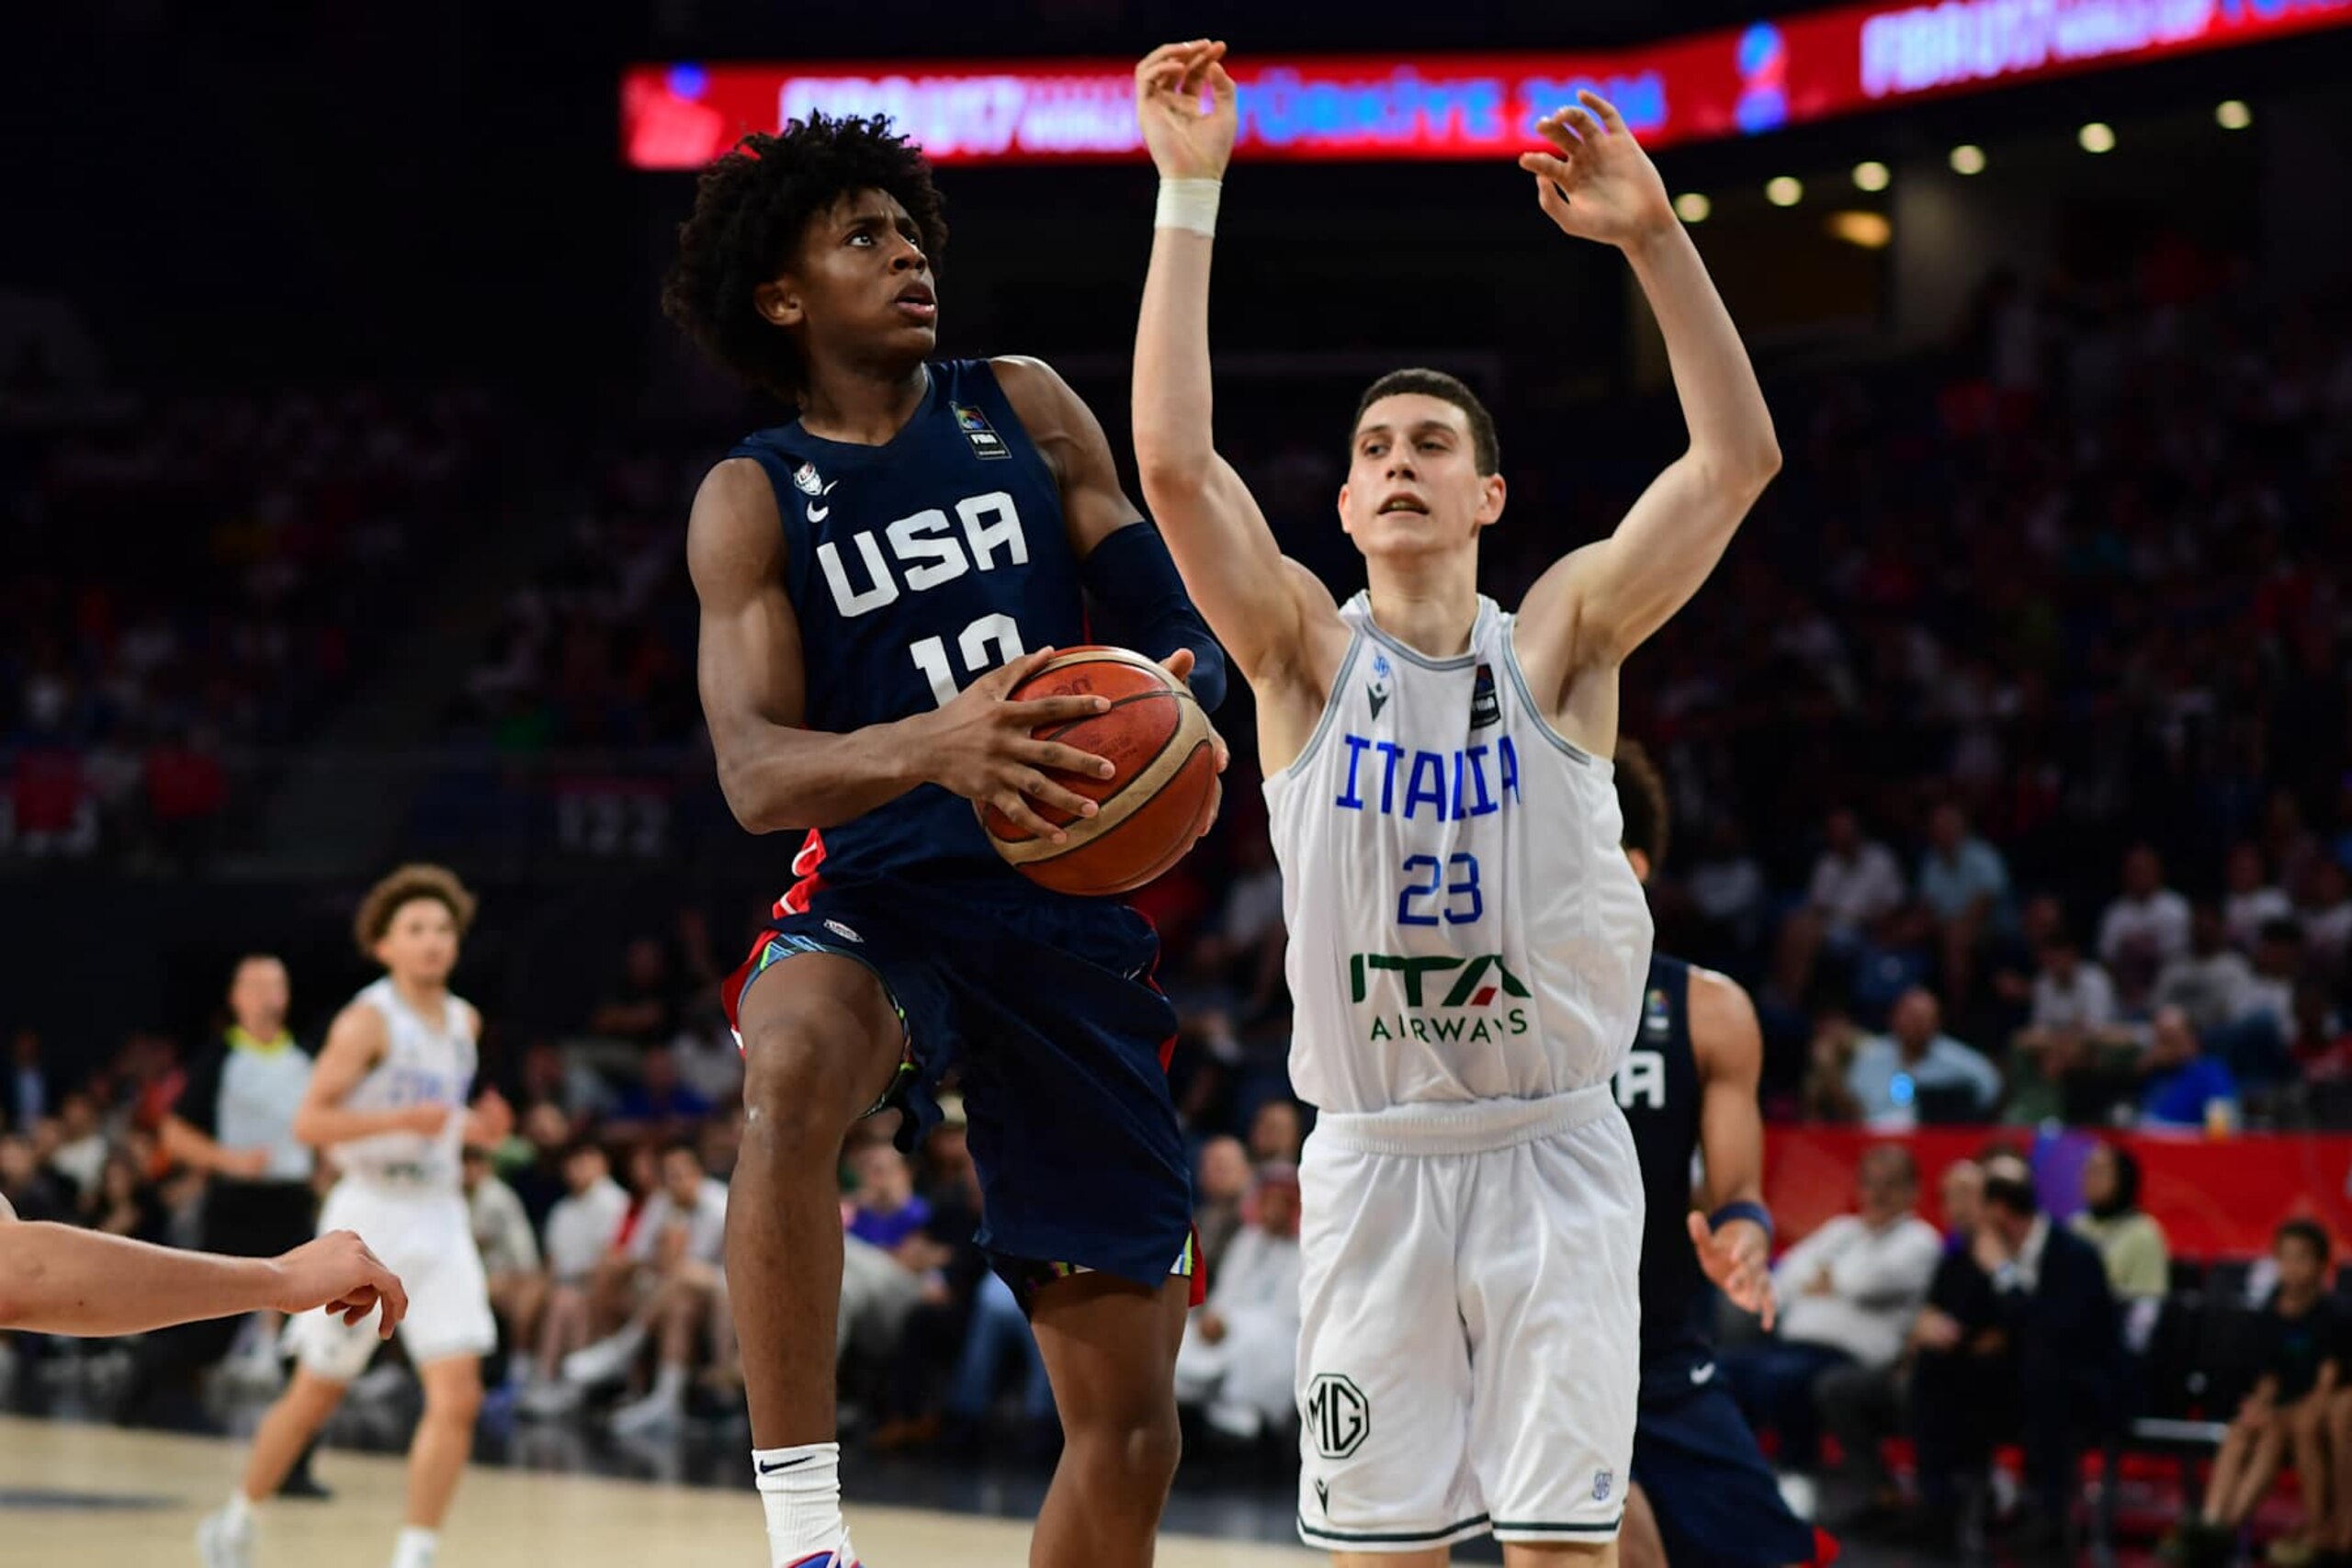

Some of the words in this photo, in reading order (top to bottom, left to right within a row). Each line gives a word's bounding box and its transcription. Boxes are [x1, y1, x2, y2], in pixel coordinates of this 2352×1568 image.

[817, 491, 1028, 617] USA
[1336, 734, 1521, 823] ITALIA
[1396, 852, 1484, 927] 23
[1350, 953, 1532, 1008] ITA
[1308, 1381, 1362, 1451] MG
